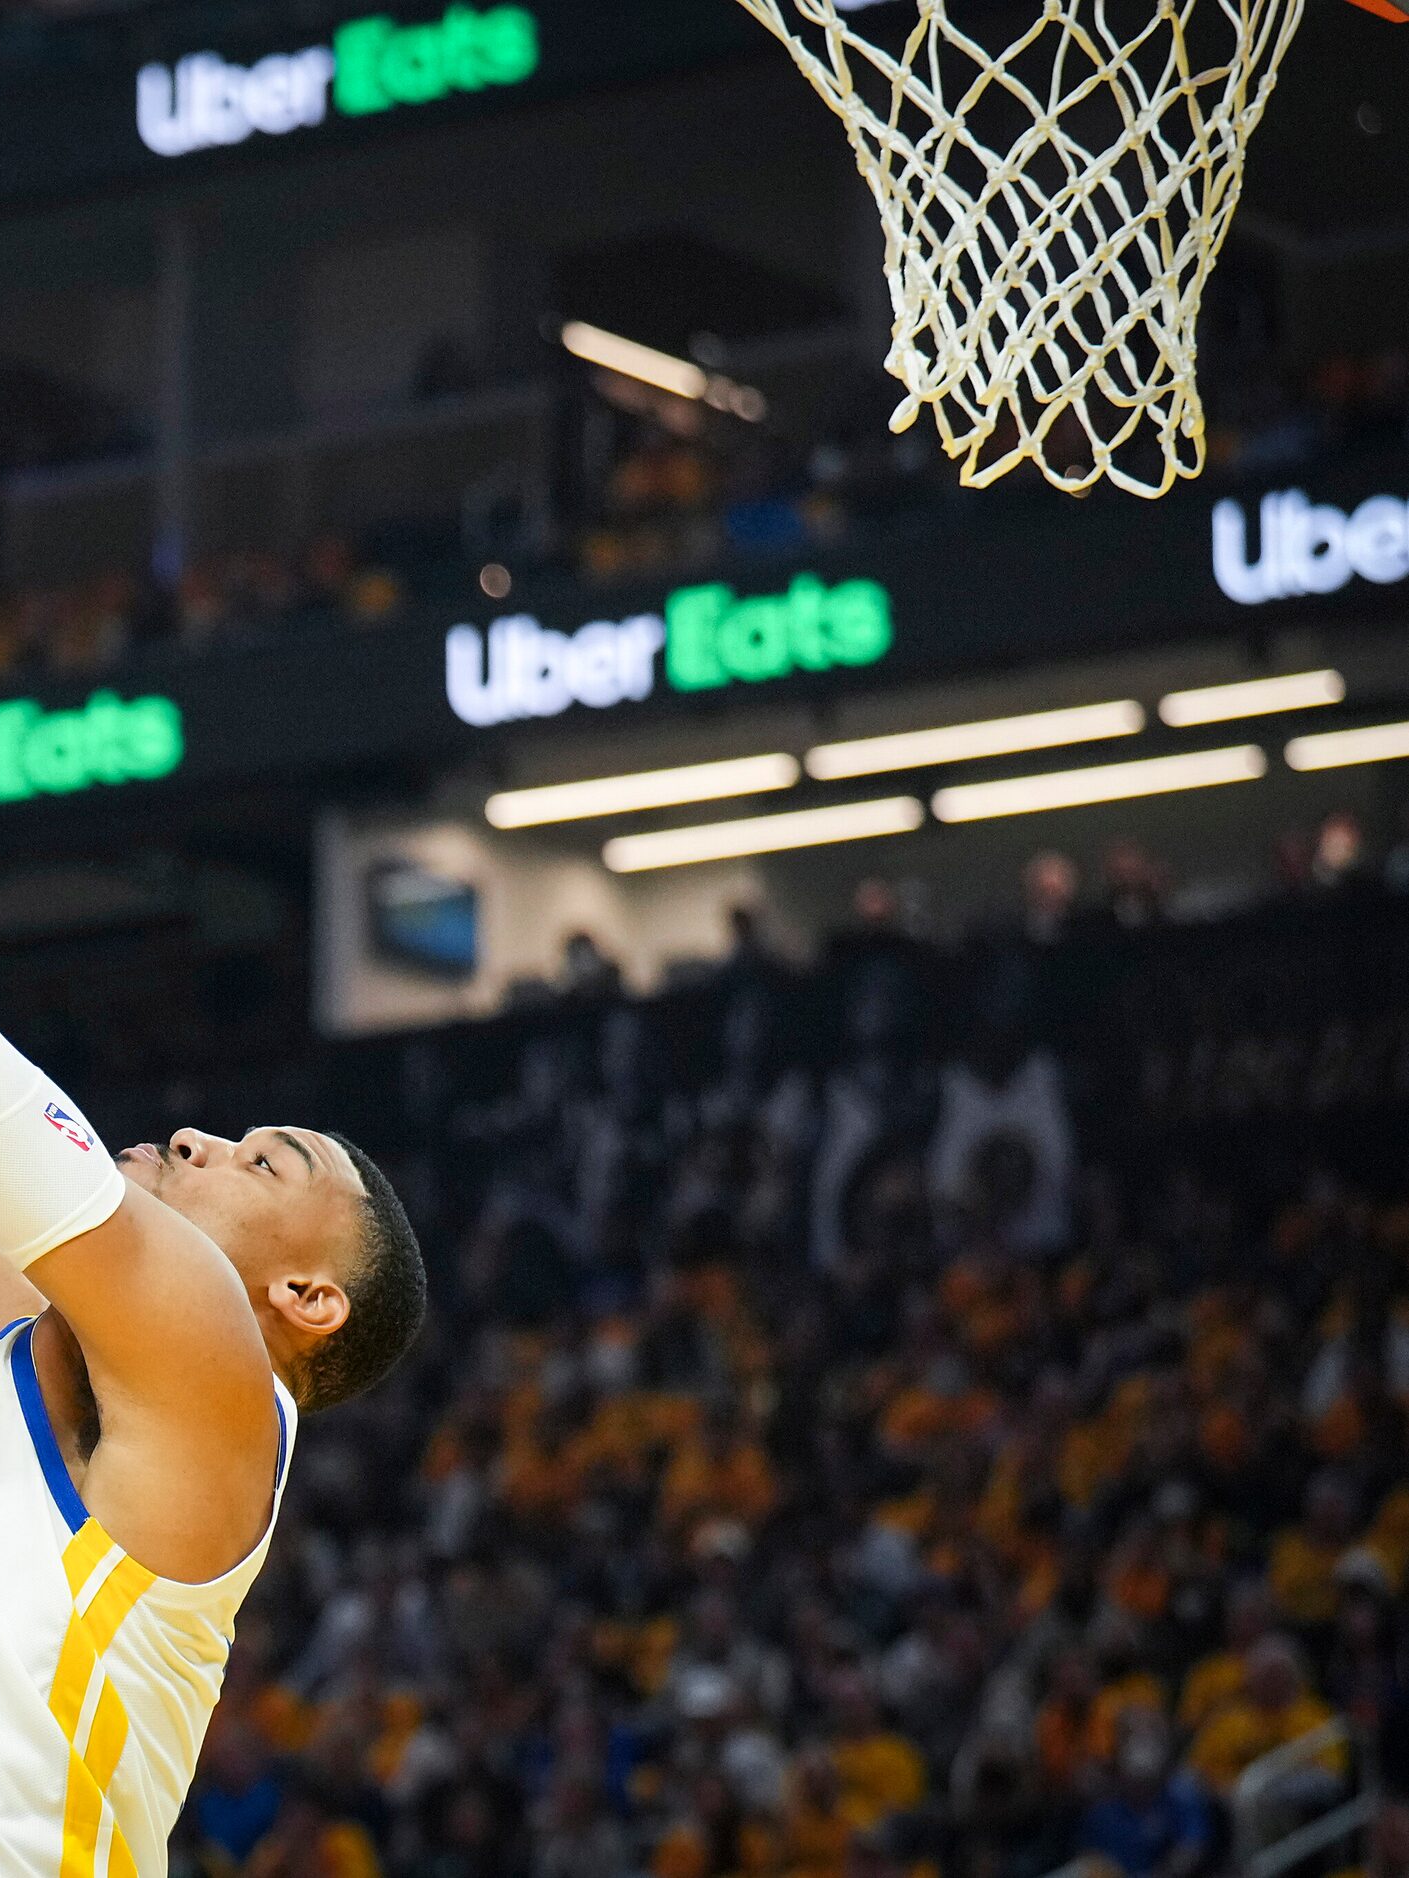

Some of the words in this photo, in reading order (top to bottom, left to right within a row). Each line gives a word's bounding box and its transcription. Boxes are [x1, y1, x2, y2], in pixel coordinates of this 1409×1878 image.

[135, 48, 335, 157] Uber
[332, 4, 539, 117] Eats
[445, 614, 666, 727] Uber
[664, 572, 893, 693] Eats
